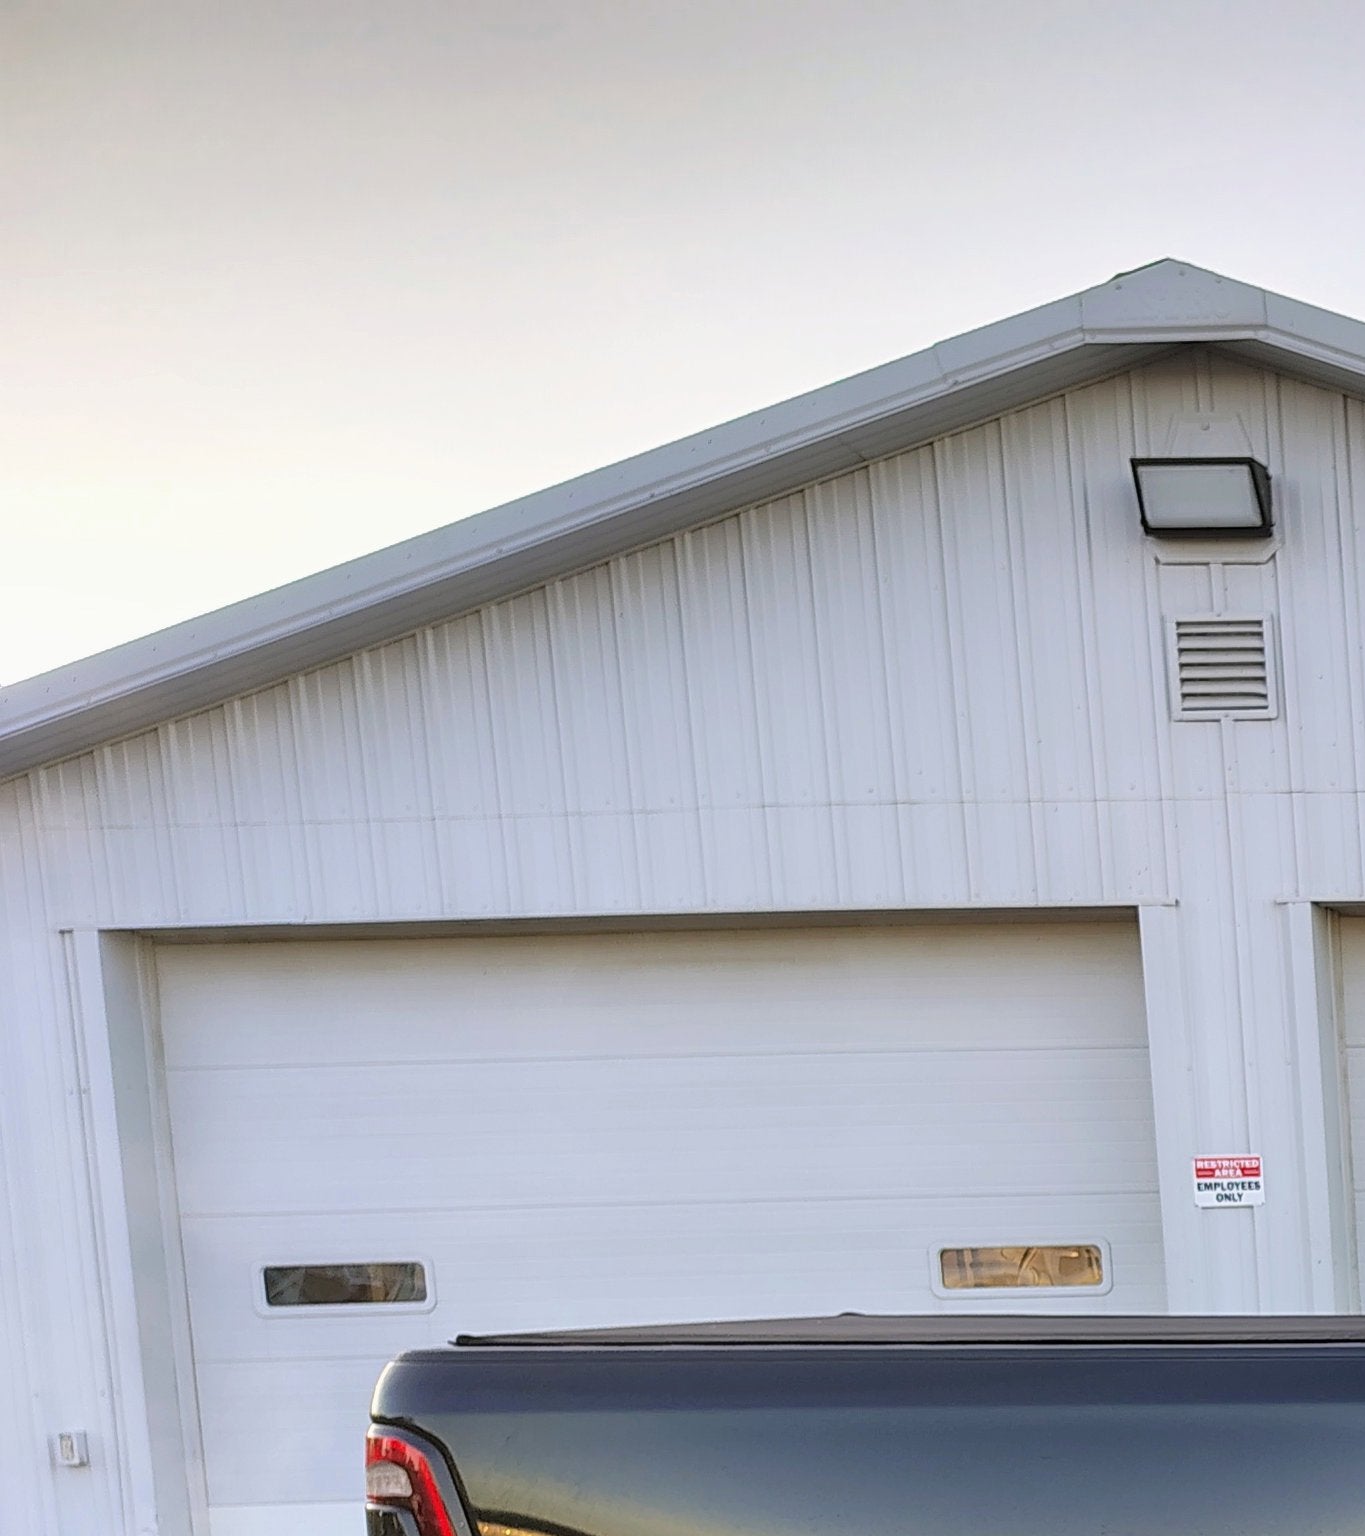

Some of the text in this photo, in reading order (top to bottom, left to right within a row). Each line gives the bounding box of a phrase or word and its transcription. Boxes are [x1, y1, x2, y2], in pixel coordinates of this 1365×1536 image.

[1196, 1159, 1259, 1169] RESTRICTED
[1214, 1168, 1243, 1177] AREA
[1197, 1181, 1261, 1191] EMPLOYEES
[1216, 1193, 1243, 1203] ONLY
